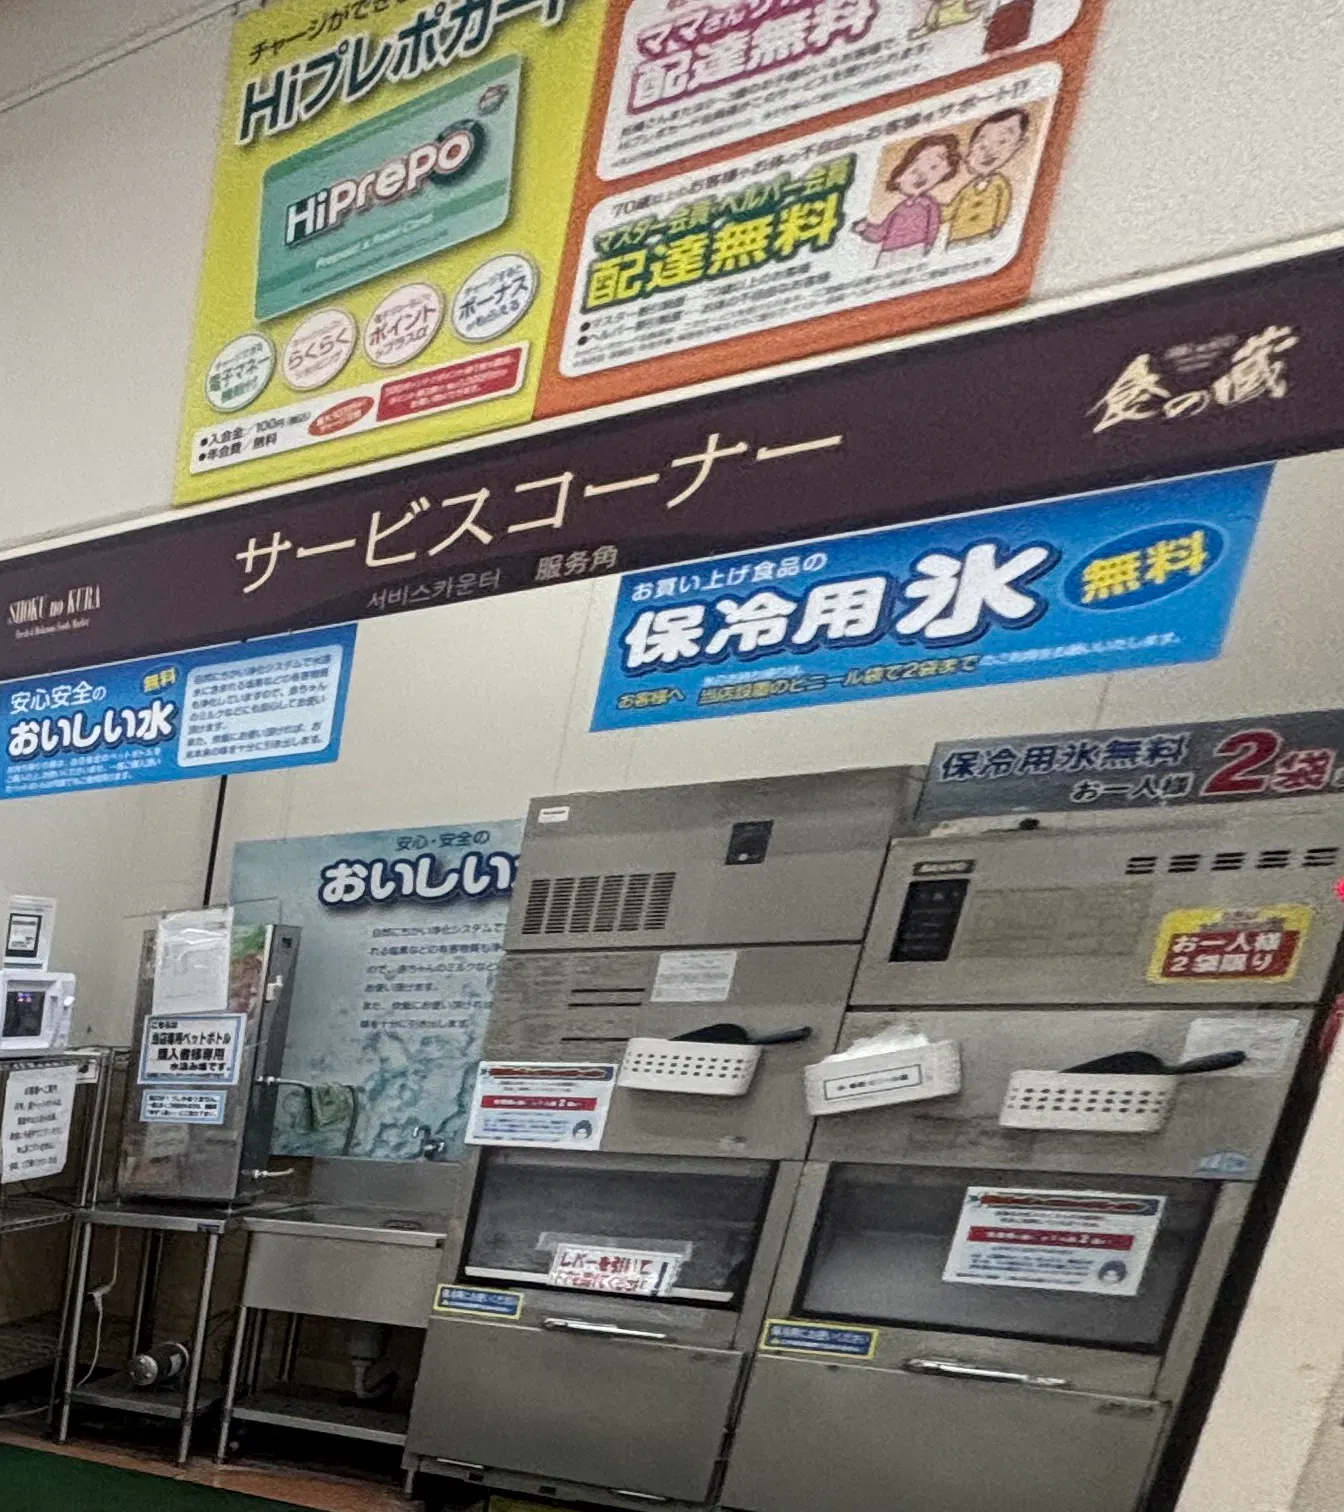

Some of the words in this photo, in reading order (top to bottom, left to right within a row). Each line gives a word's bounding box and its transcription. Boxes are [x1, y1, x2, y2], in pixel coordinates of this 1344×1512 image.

[583, 190, 840, 312] 配達無料
[458, 274, 529, 322] ボーナス
[368, 304, 438, 347] ポイント
[287, 329, 351, 371] らくらく
[1084, 325, 1301, 434] 食の蔵
[234, 432, 844, 595] サービスコーナー
[534, 544, 618, 584] 服务角
[630, 551, 830, 602] お買い上げ食品の
[1080, 530, 1208, 604] 無料
[365, 566, 502, 612] 서비스카운터
[9, 680, 108, 714] 安心安全の
[142, 666, 178, 693] 無料
[7, 699, 177, 758] おいしい水
[938, 731, 1194, 782] 保冷用氷無料
[1069, 770, 1195, 803] お一人様
[395, 829, 490, 852] 安心・安全の
[321, 852, 514, 904] おいしい
[1171, 931, 1283, 954] お一人様
